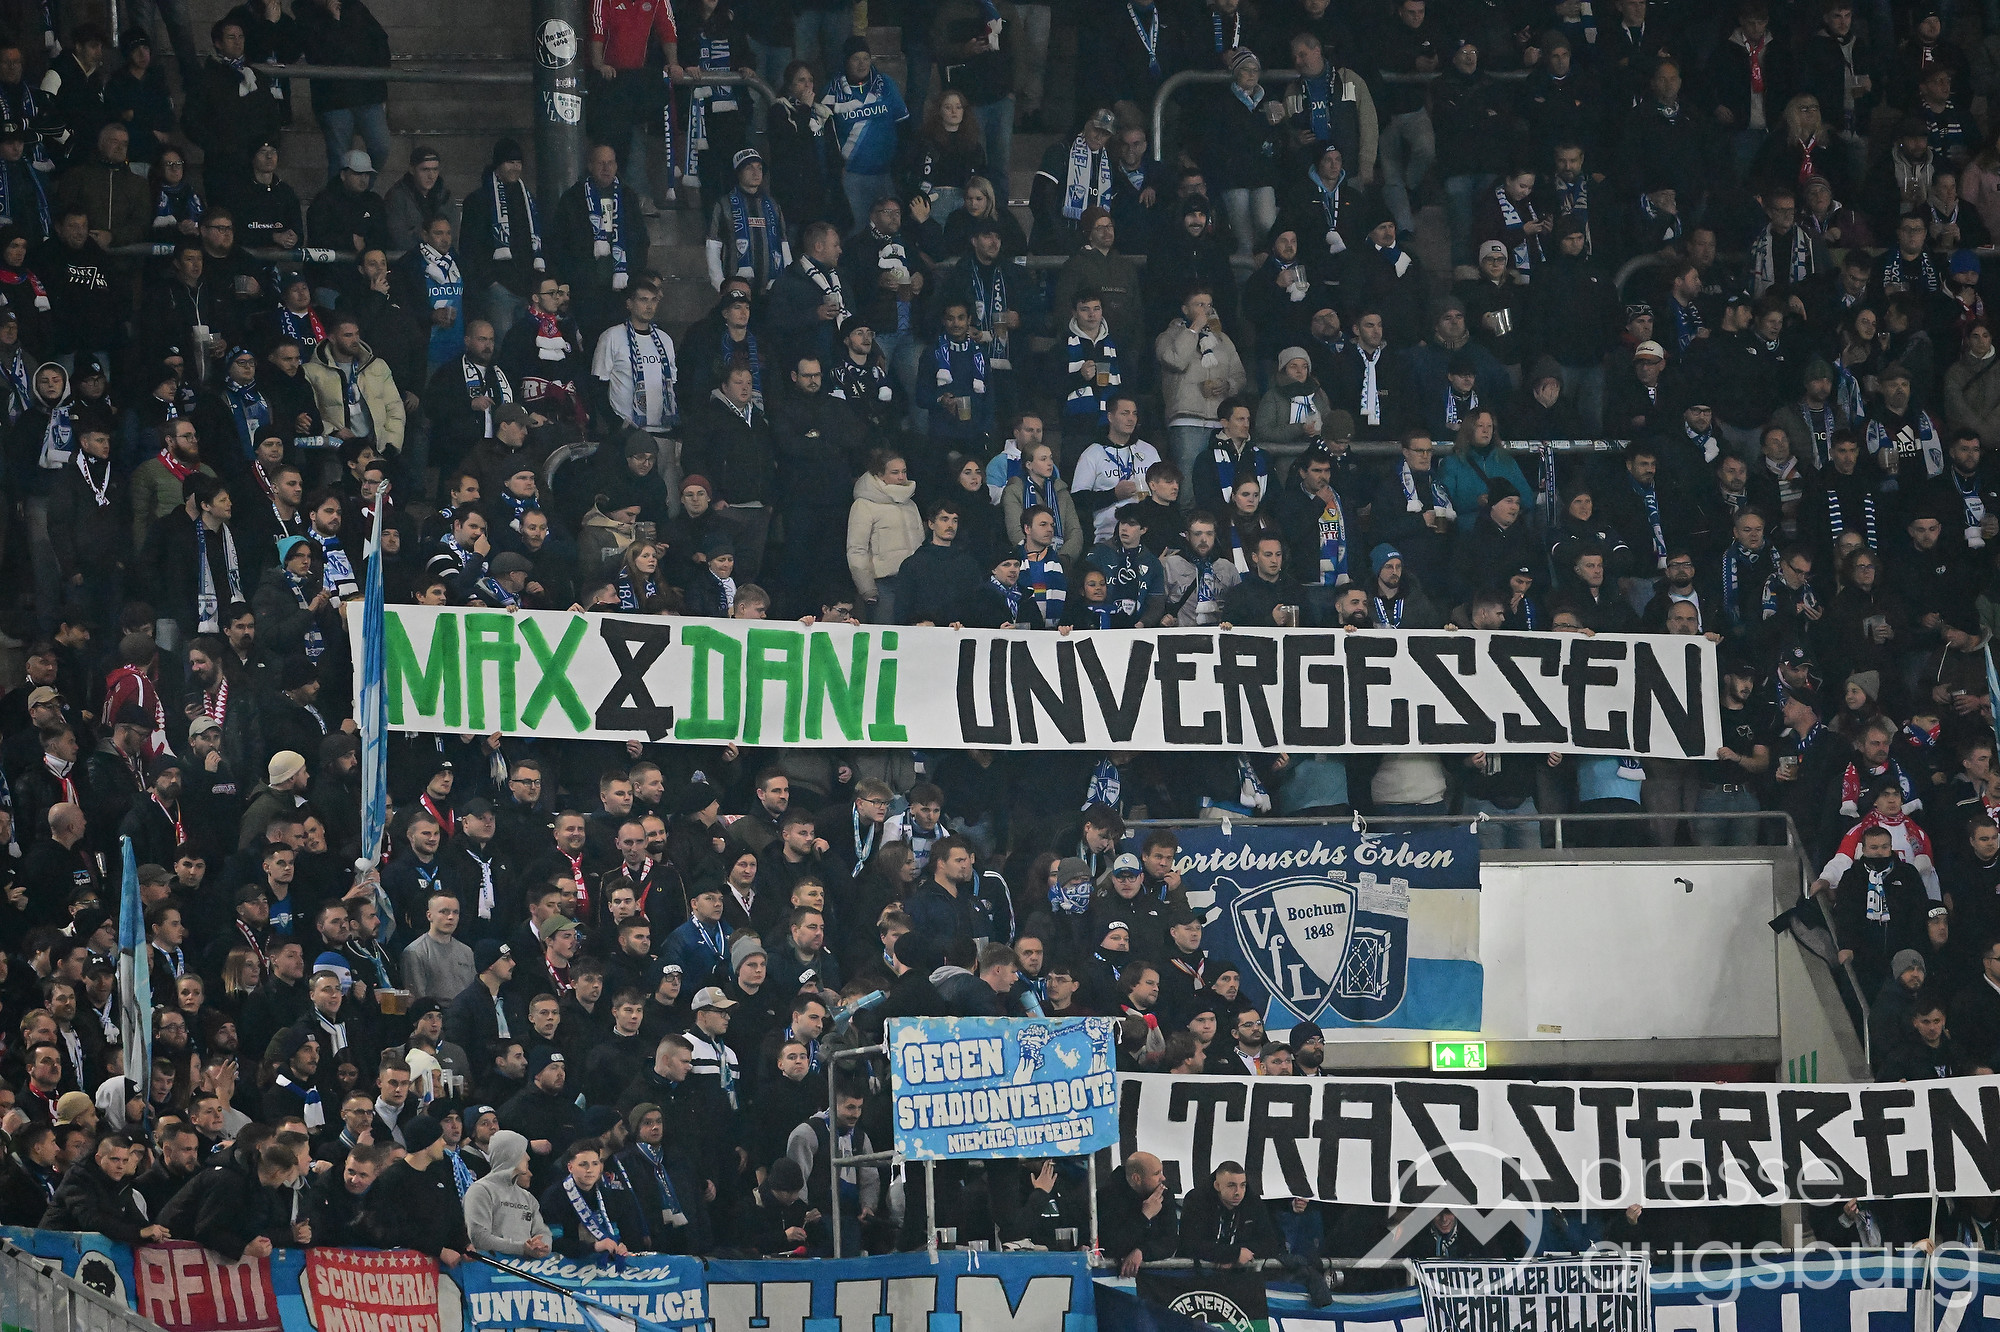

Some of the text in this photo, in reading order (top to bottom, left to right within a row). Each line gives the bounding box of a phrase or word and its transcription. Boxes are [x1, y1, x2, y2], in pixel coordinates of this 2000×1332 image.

[956, 634, 1704, 756] UNVERGESSEN
[1353, 839, 1454, 868] Erben
[1287, 903, 1346, 921] Bochum
[1304, 924, 1334, 940] 1848
[903, 1038, 1004, 1085] GEGEN
[897, 1071, 1116, 1130] STADIONVERBOTE
[947, 1116, 1094, 1154] NIEMALS AUFGEBEN
[1096, 1080, 2000, 1205] LTRAS STERBEN
[315, 1264, 437, 1307] SCHICKERIA
[1425, 1264, 1639, 1295] TROTZ ALLER VERBOTE
[1545, 1295, 1638, 1332] ALLEIN
